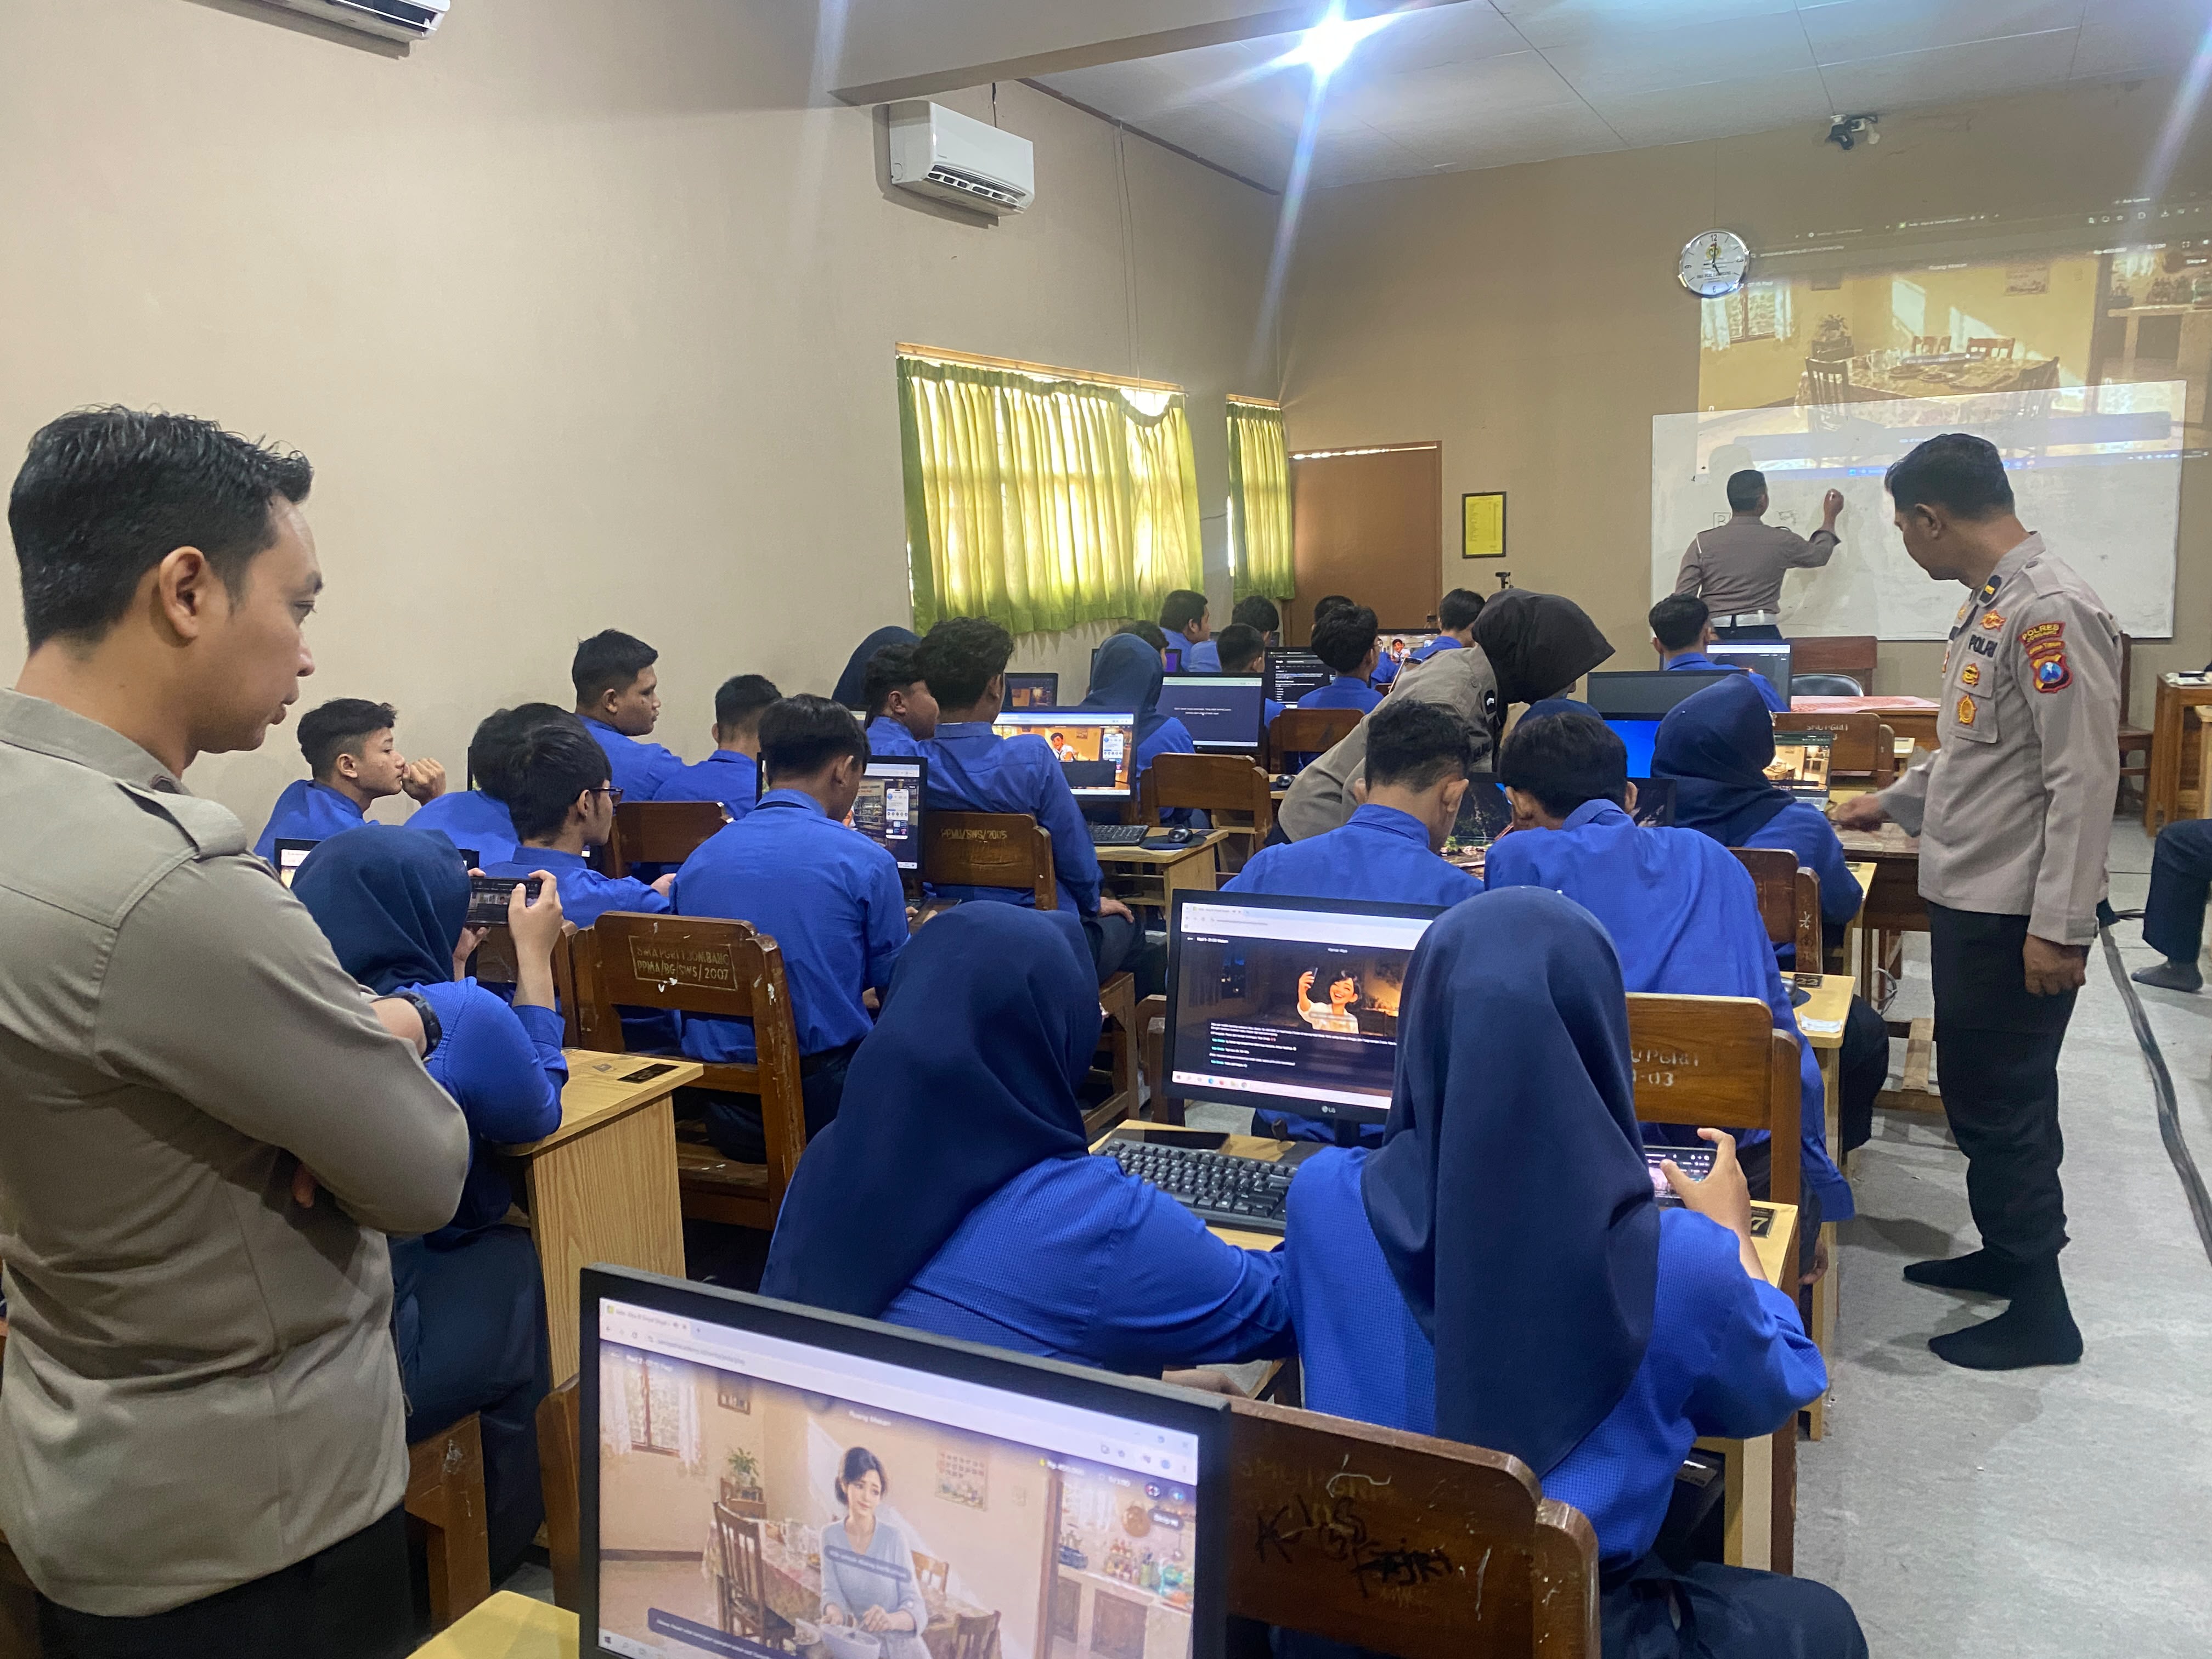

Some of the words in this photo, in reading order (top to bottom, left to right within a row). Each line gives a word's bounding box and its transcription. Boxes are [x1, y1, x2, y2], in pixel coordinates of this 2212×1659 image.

[2022, 624, 2059, 641] POLRES
[1968, 634, 1998, 658] POLRI
[1796, 978, 1818, 986] 22
